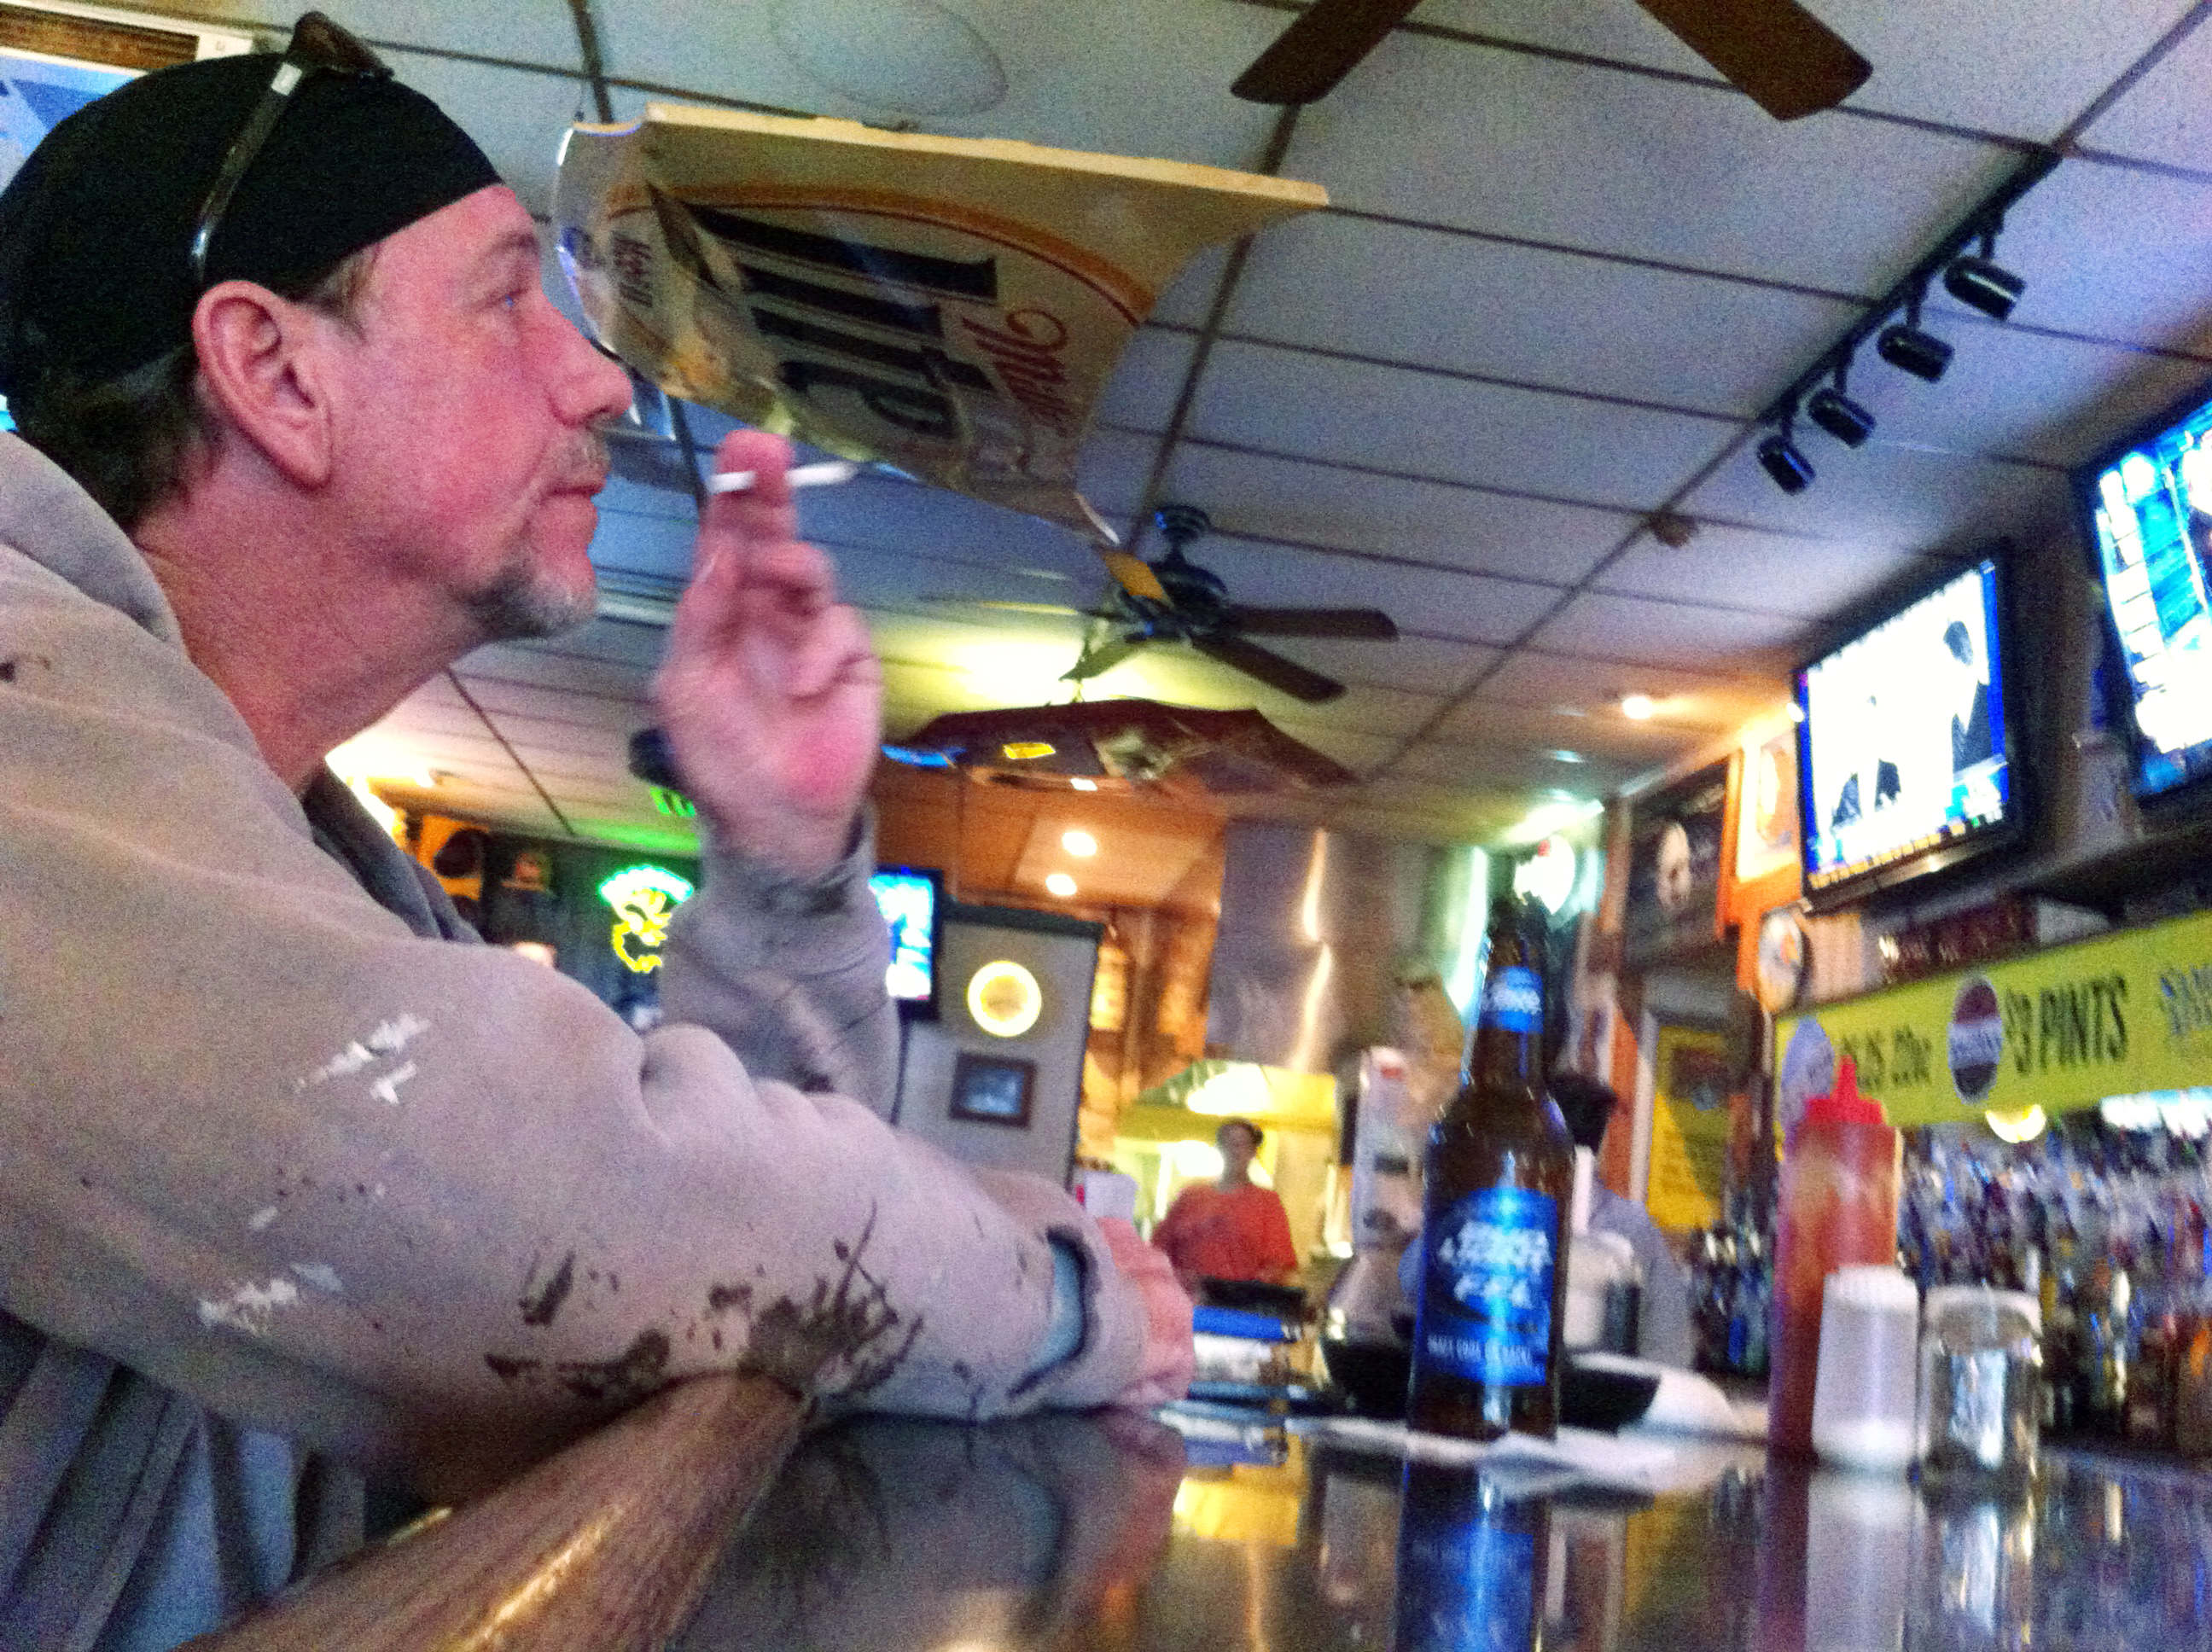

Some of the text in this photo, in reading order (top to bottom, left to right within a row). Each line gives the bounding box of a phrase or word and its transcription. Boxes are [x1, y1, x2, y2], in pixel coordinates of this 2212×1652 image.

[686, 203, 998, 440] Lite
[963, 309, 1071, 437] Miller
[2038, 974, 2128, 1072] PINTS
